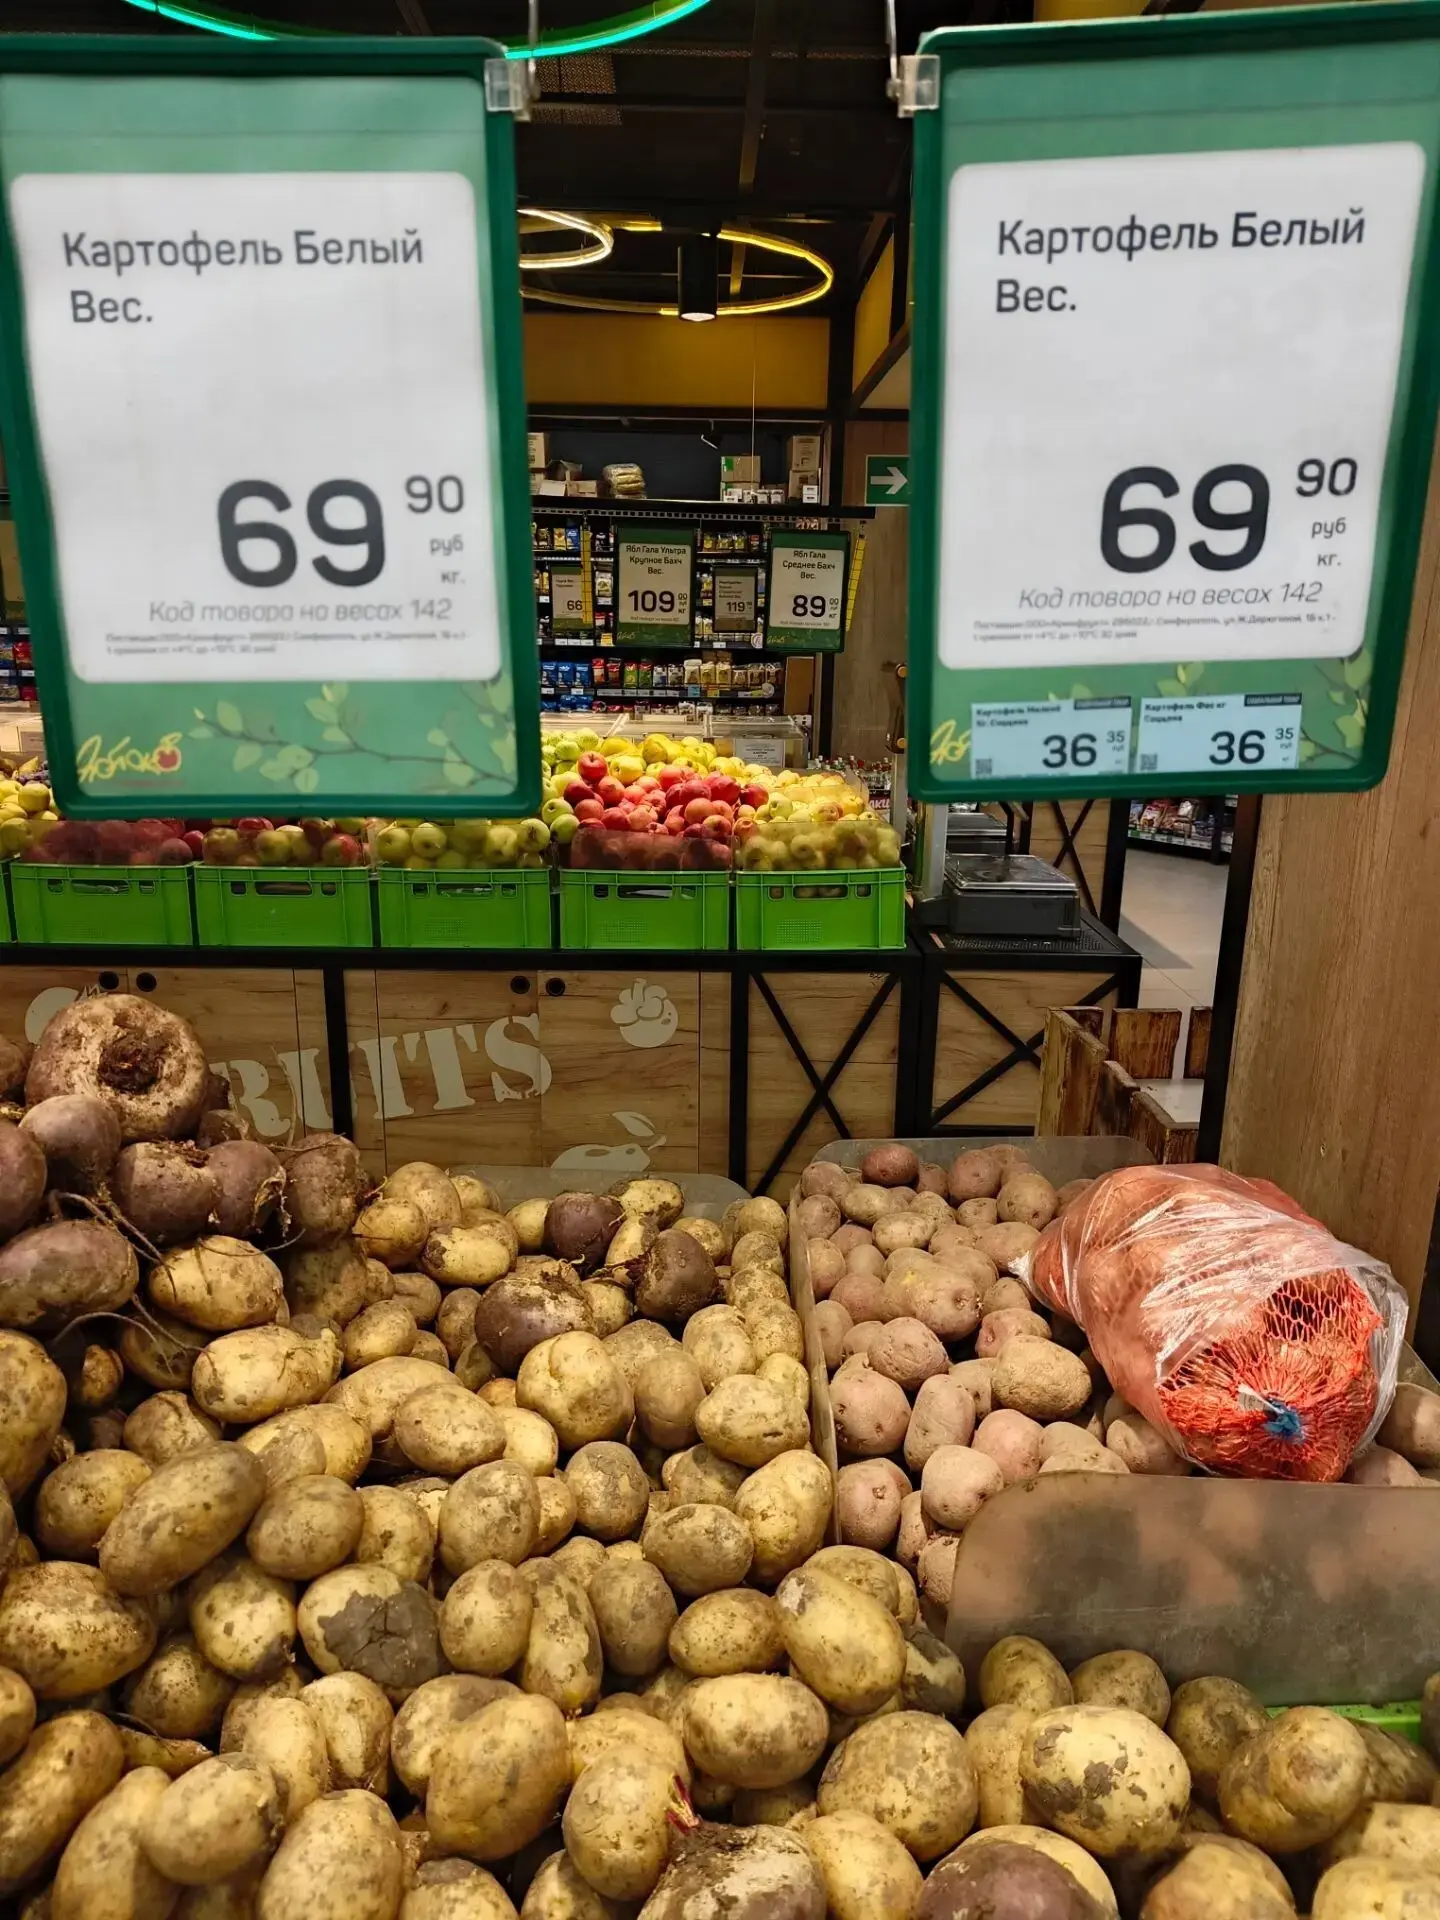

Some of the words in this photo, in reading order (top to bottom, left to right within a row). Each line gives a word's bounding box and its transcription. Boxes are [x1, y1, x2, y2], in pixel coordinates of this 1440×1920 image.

[998, 214, 1219, 265] Картофель
[1231, 207, 1365, 248] Белый
[62, 229, 283, 277] Картофель
[293, 228, 423, 265] Белый
[70, 289, 153, 324] Вес.
[995, 278, 1077, 313] Вес.
[1100, 463, 1270, 574] 69
[1295, 457, 1358, 498] 90
[217, 478, 386, 589] 69
[404, 474, 465, 514] 90
[1311, 516, 1347, 540] руб
[429, 534, 464, 557] руб
[625, 545, 641, 554] Ябл
[642, 545, 658, 554] Гала
[660, 546, 687, 555] Ультра
[793, 550, 808, 559] Ябл
[809, 551, 827, 560] Гала
[629, 555, 663, 565] Крупное
[647, 566, 665, 575] Вес.
[782, 560, 816, 570] Среднее
[1317, 553, 1341, 567] кг.
[440, 570, 466, 585] кг.
[800, 571, 817, 580] Вес.
[566, 599, 583, 611] 66
[627, 589, 676, 613] 109
[677, 592, 689, 601] 00
[725, 600, 746, 613] 119
[791, 594, 827, 618] 89
[828, 597, 840, 606] 00
[1018, 586, 1064, 609] Код
[1068, 589, 1162, 608] товара
[1166, 589, 1197, 606] на
[1201, 587, 1273, 605] весах
[1282, 581, 1323, 603] 142
[149, 600, 195, 624] Код
[200, 604, 295, 624] товара
[299, 604, 330, 622] на
[334, 603, 403, 622] весах
[410, 597, 453, 621] 142
[1042, 733, 1097, 769] 36
[1106, 730, 1125, 744] 35
[1209, 729, 1266, 766] 36
[1275, 727, 1294, 741] 35
[196, 1012, 553, 1138] RUITS
